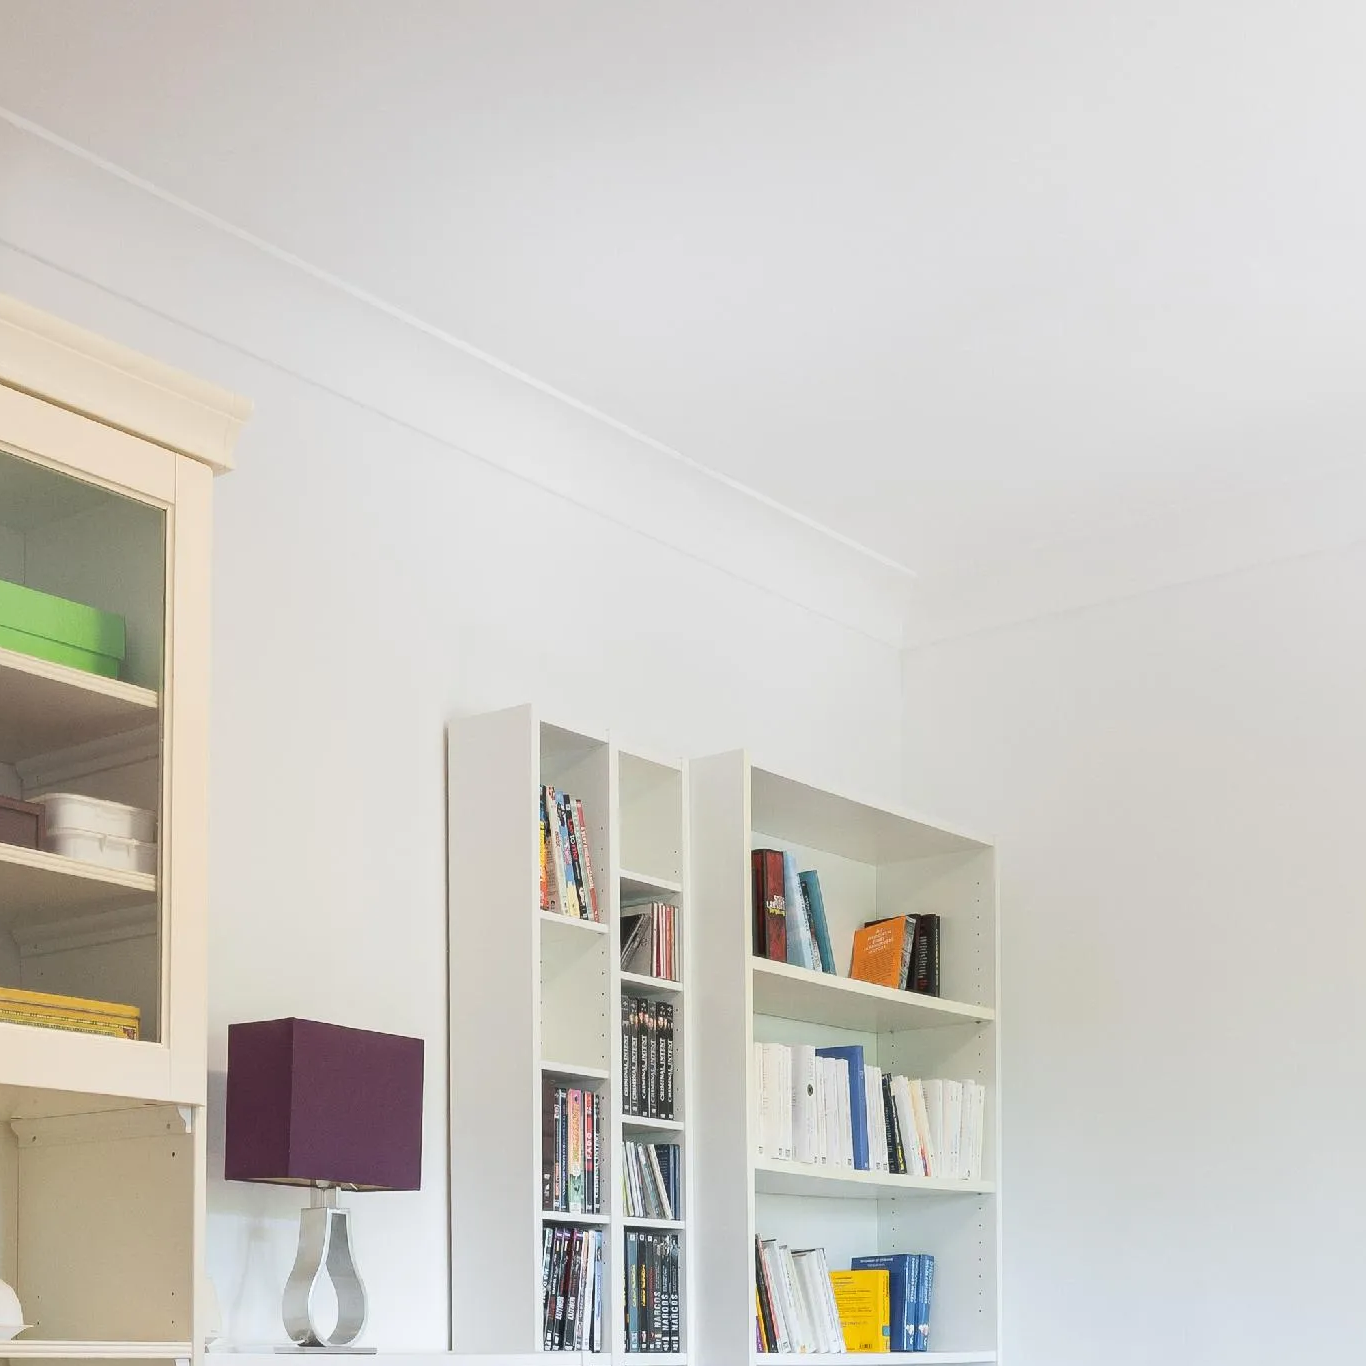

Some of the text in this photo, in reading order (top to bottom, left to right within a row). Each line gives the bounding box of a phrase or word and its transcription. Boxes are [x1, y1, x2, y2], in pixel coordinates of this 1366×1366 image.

[653, 1291, 661, 1328] NARCOS
[661, 1294, 669, 1331] NARCOS
[671, 1294, 679, 1331] NARCOS
